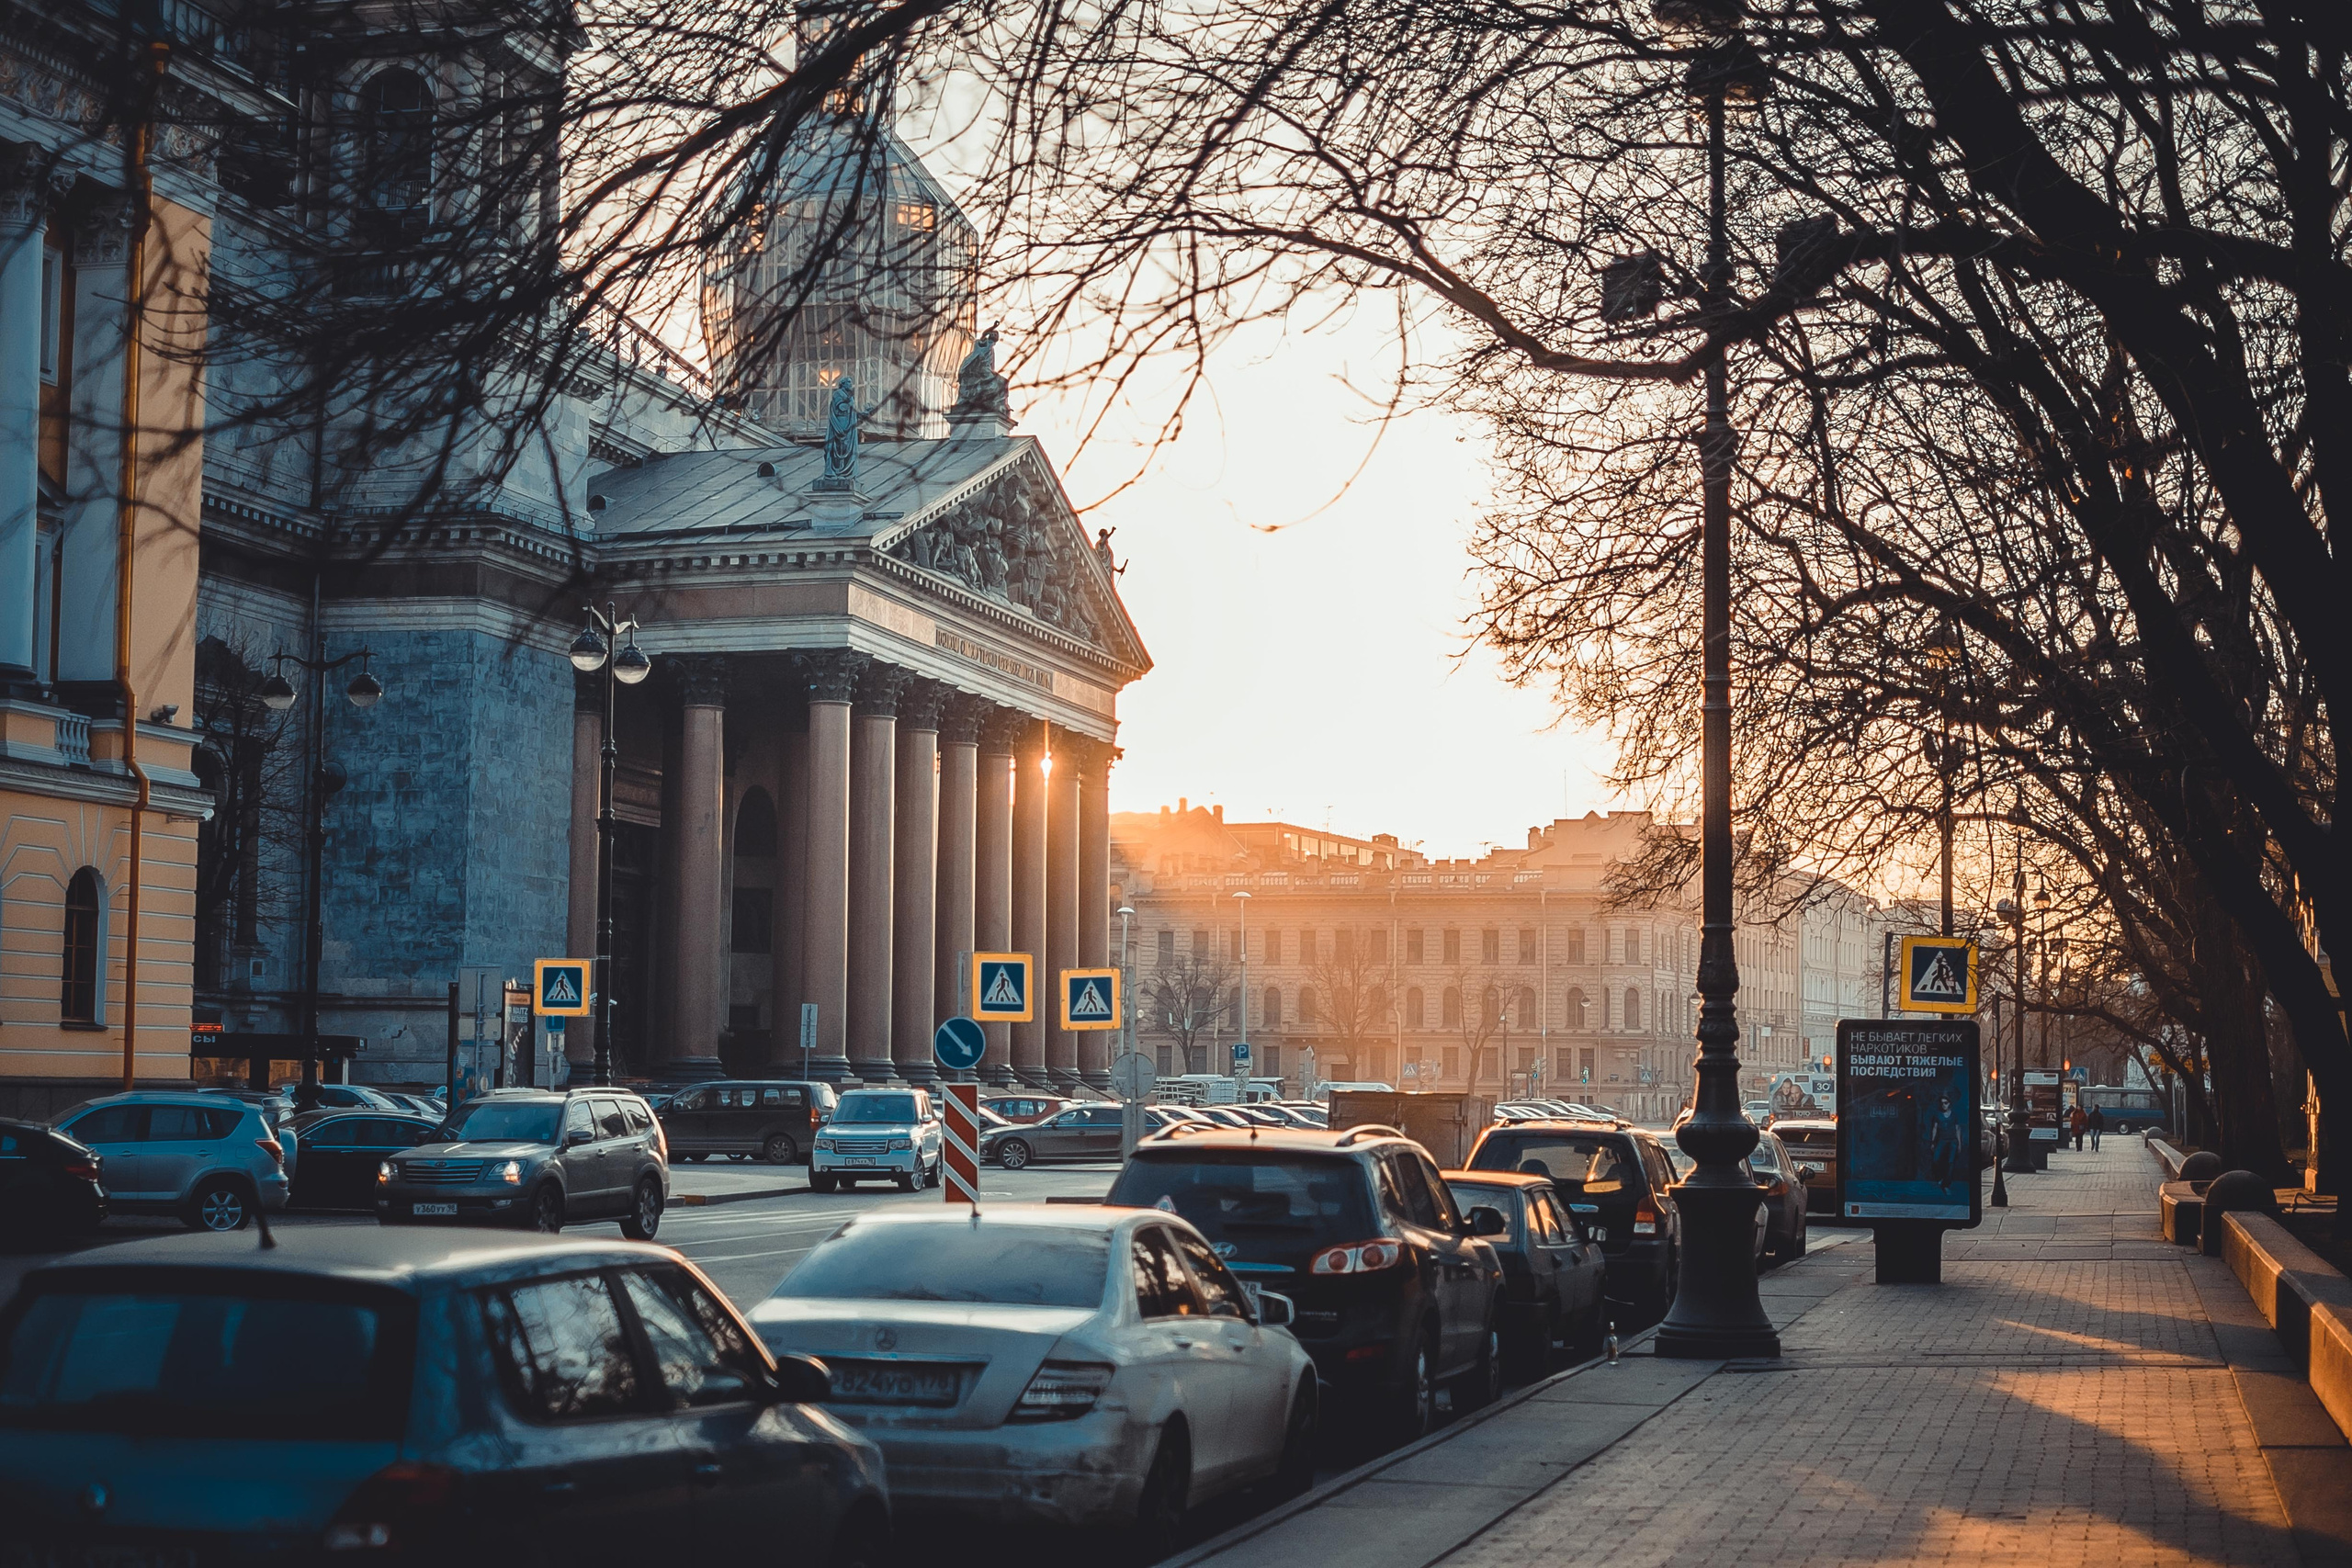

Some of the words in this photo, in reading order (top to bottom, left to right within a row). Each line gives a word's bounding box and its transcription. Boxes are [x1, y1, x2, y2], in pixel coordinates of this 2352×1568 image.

[1850, 1032, 1866, 1042] НЕ
[1869, 1032, 1915, 1043] БЫВАЕТ
[1917, 1032, 1962, 1043] ЛЕГКИХ
[1238, 1045, 1248, 1058] P
[1850, 1043, 1928, 1054] НАРКОТИКОВ
[1850, 1055, 1902, 1066] БЫВАЮТ
[1905, 1055, 1963, 1066] ТЯЖЕЛЫЕ
[1850, 1066, 1937, 1078] ПОСЛЕДСТВИЯ
